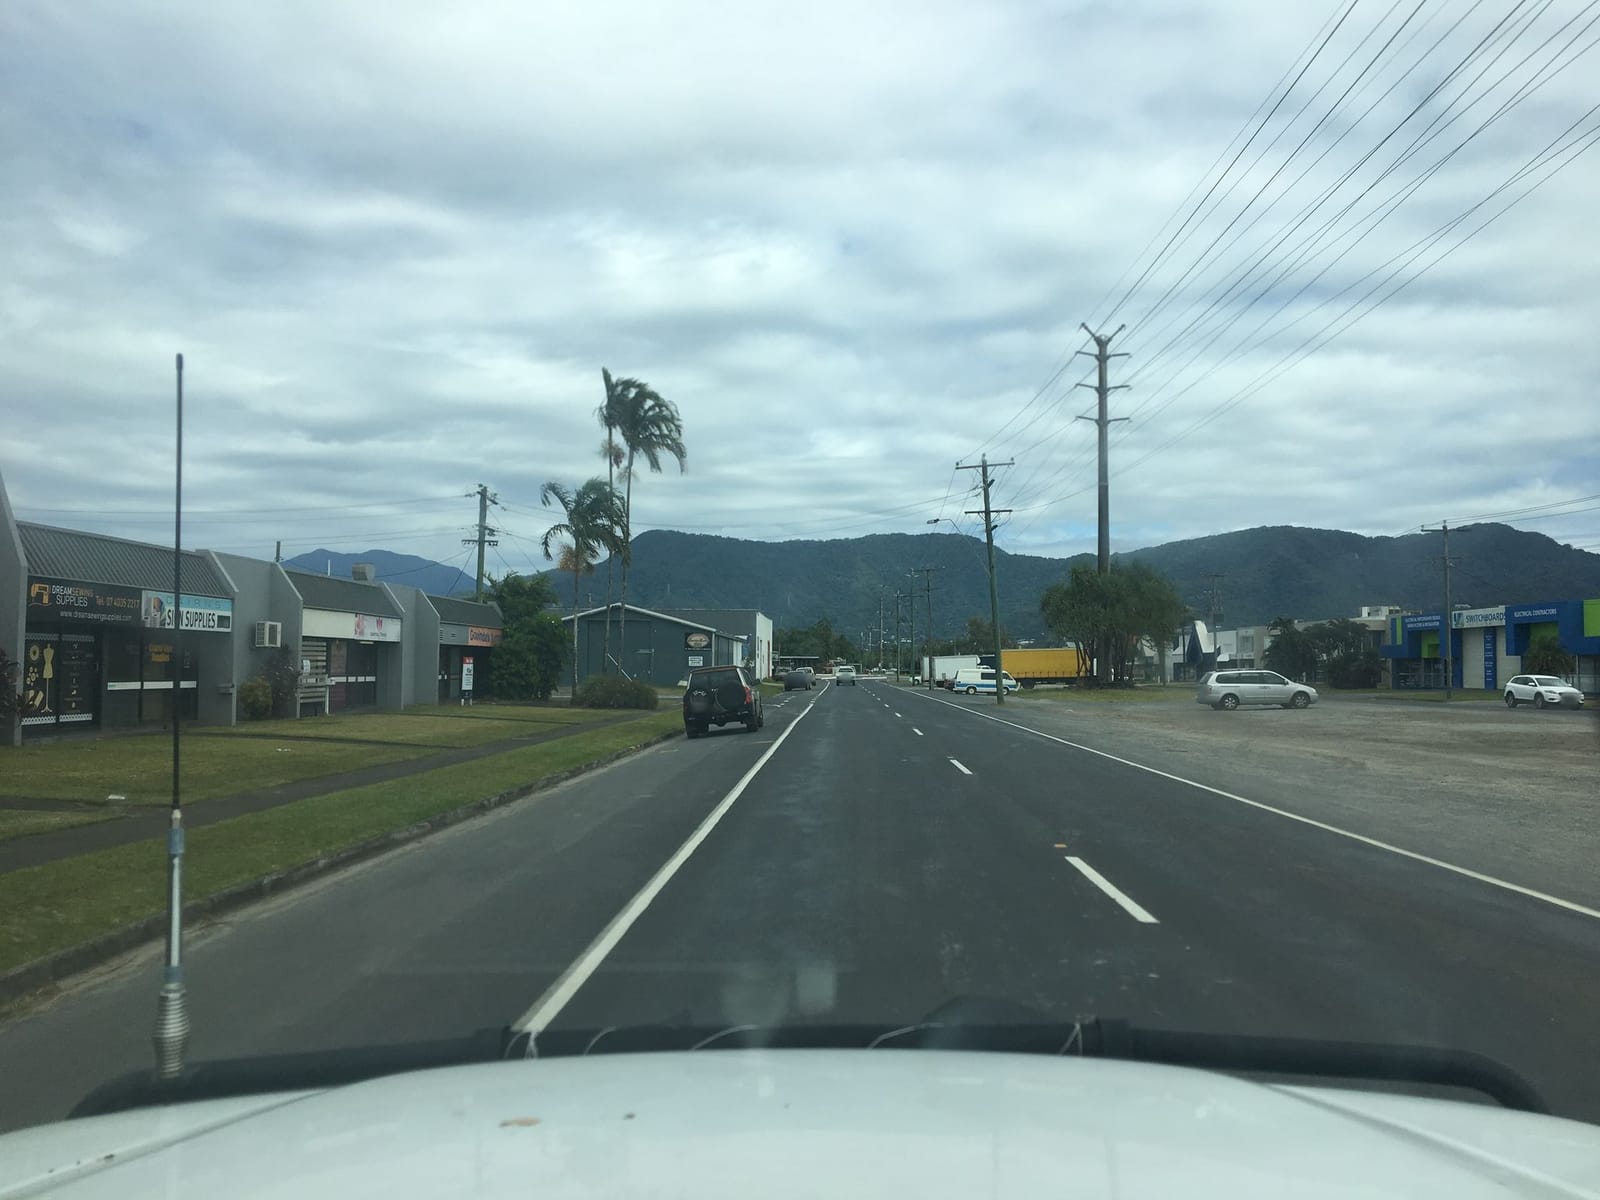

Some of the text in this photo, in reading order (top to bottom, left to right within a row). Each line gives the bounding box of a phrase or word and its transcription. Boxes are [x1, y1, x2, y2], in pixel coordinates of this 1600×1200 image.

[56, 595, 88, 607] SUPPLIES
[166, 609, 216, 629] SIN SUPPLIES
